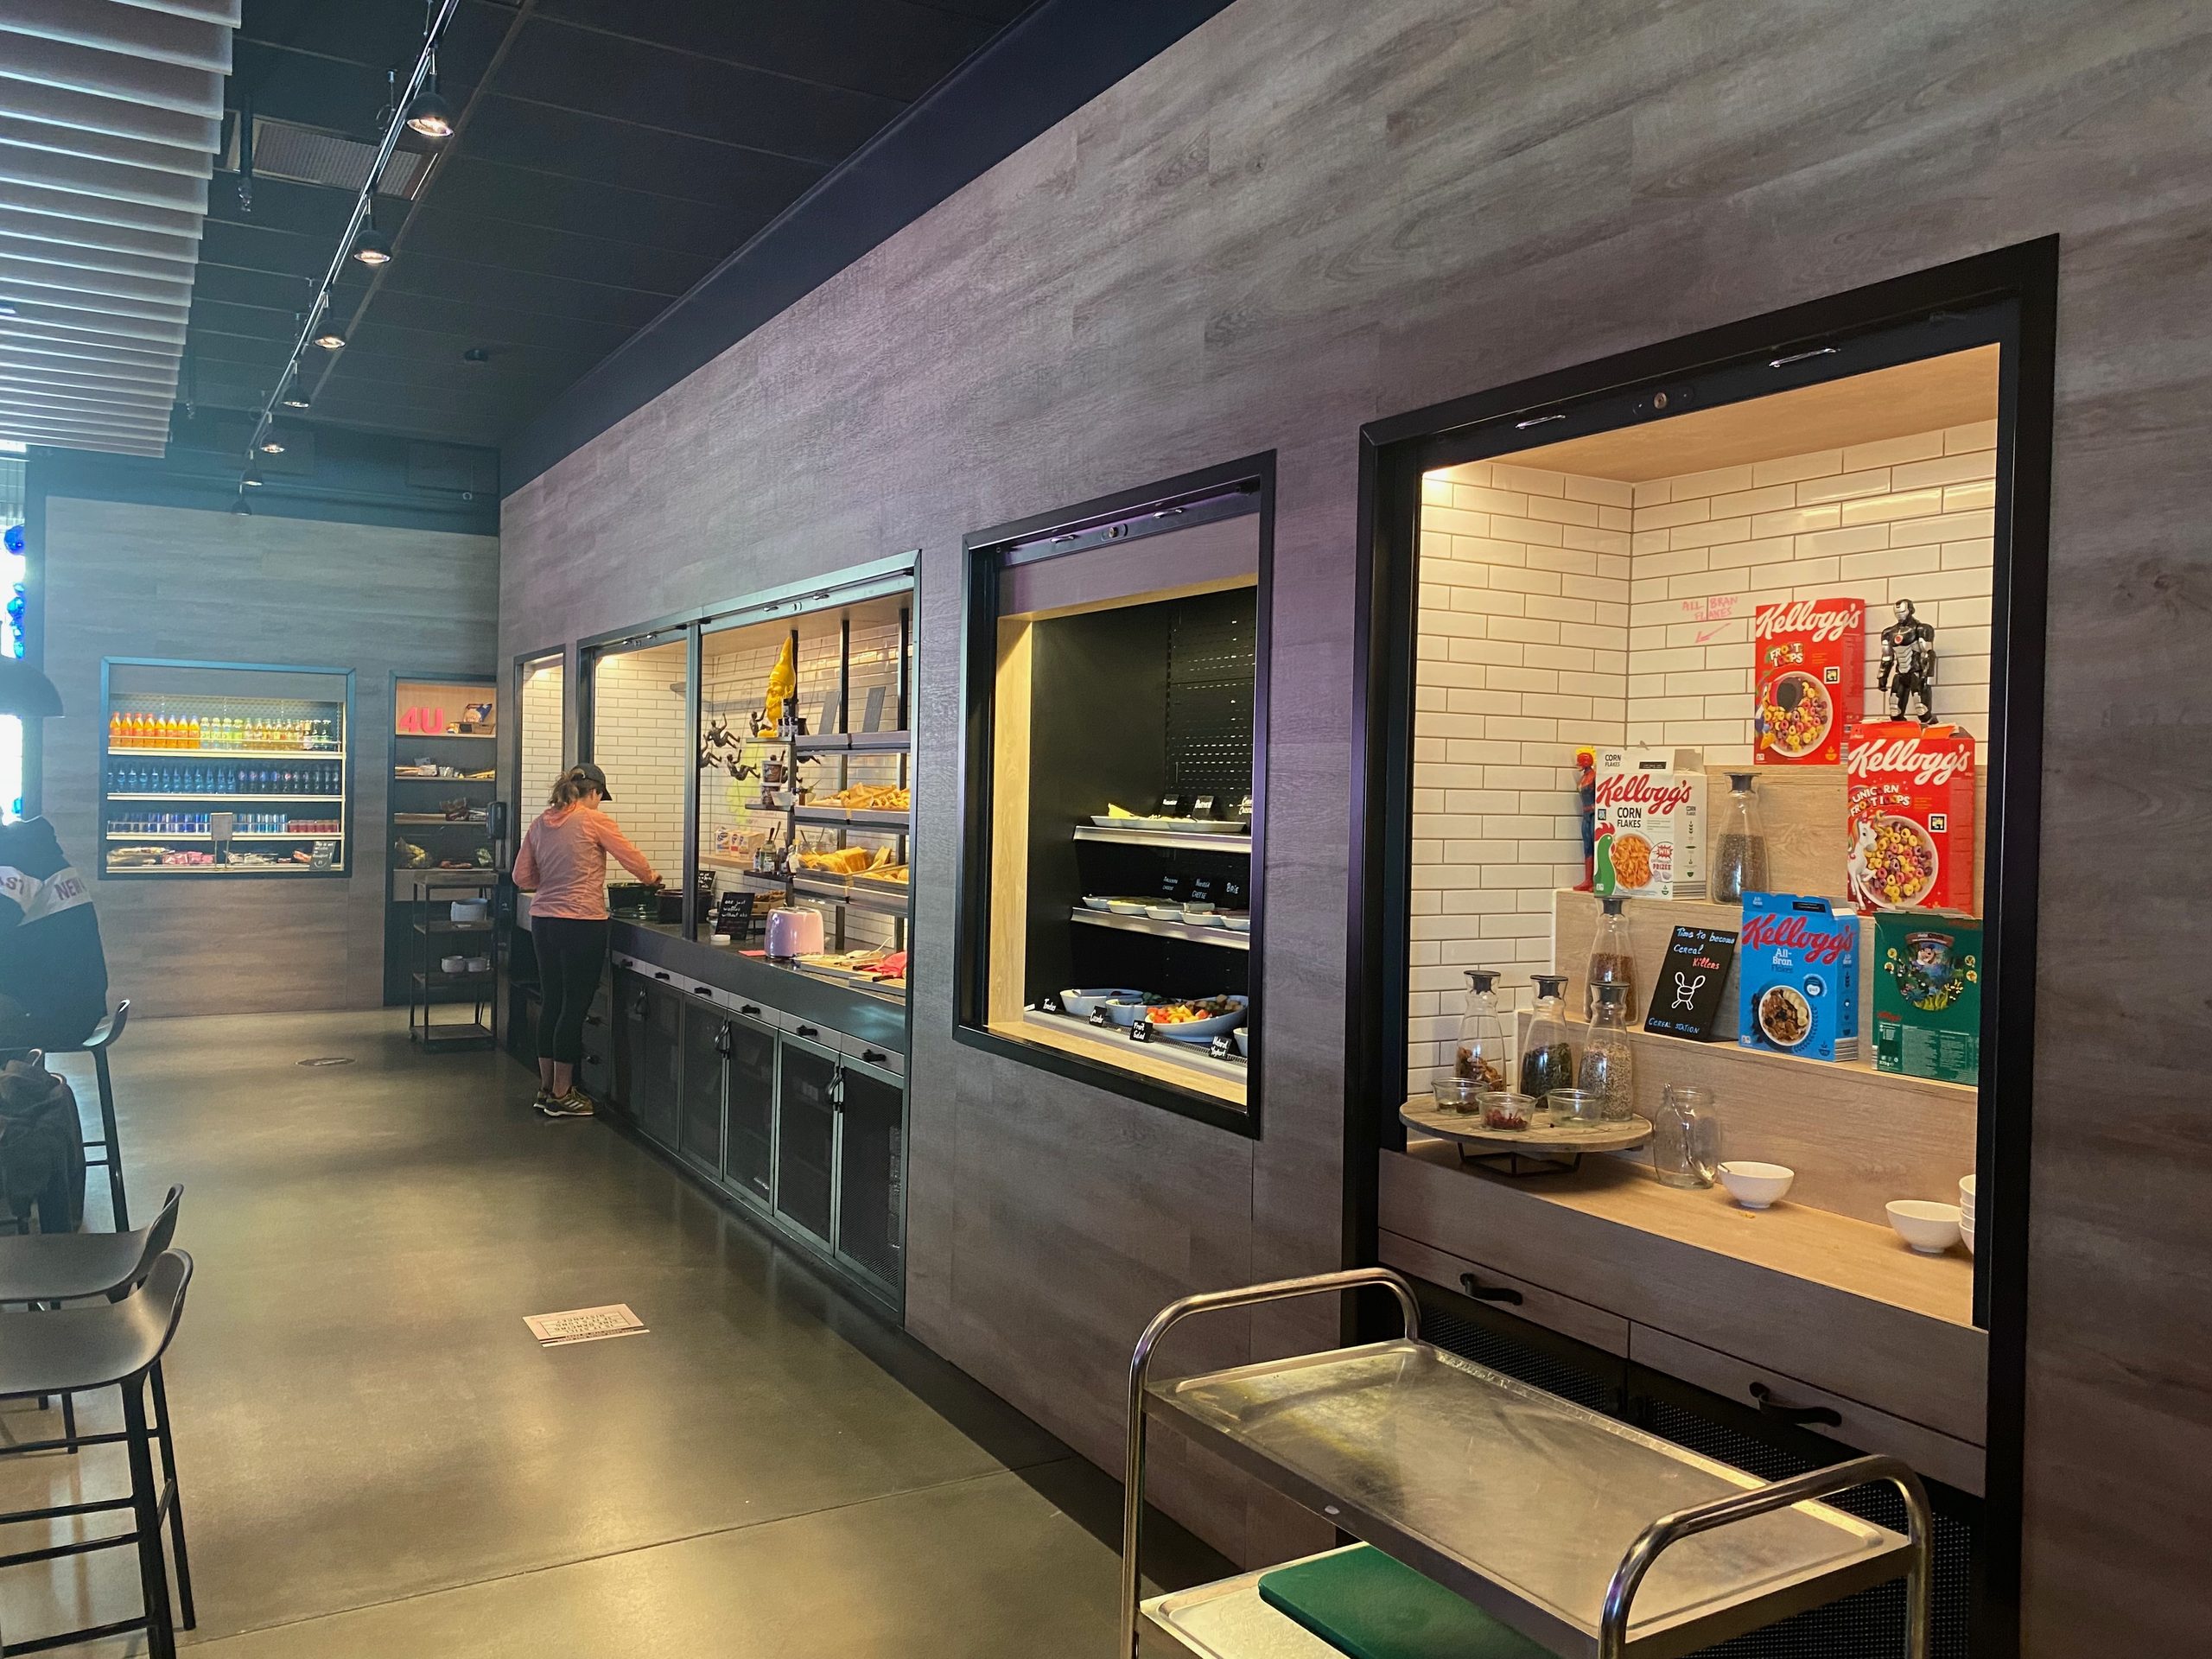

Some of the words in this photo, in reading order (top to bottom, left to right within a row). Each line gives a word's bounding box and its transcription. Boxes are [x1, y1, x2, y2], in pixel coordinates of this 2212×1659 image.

[1682, 601, 1705, 611] ALL
[1710, 596, 1738, 608] BRAN
[1694, 607, 1732, 620] FLAKES
[1756, 600, 1862, 642] Kellogg's
[399, 706, 443, 734] 4U
[1848, 739, 1971, 785] Kellogg's
[1596, 773, 1692, 815] Kellogg's
[1617, 807, 1642, 819] CORN
[1617, 819, 1641, 829] FLAKES
[1696, 930, 1707, 939] to
[1709, 932, 1735, 944] become
[1742, 913, 1854, 965] Kellogg's
[1673, 944, 1704, 955] Cereal
[1776, 948, 1792, 957] All-
[1692, 957, 1720, 969] Killers
[1772, 956, 1793, 966] Bran
